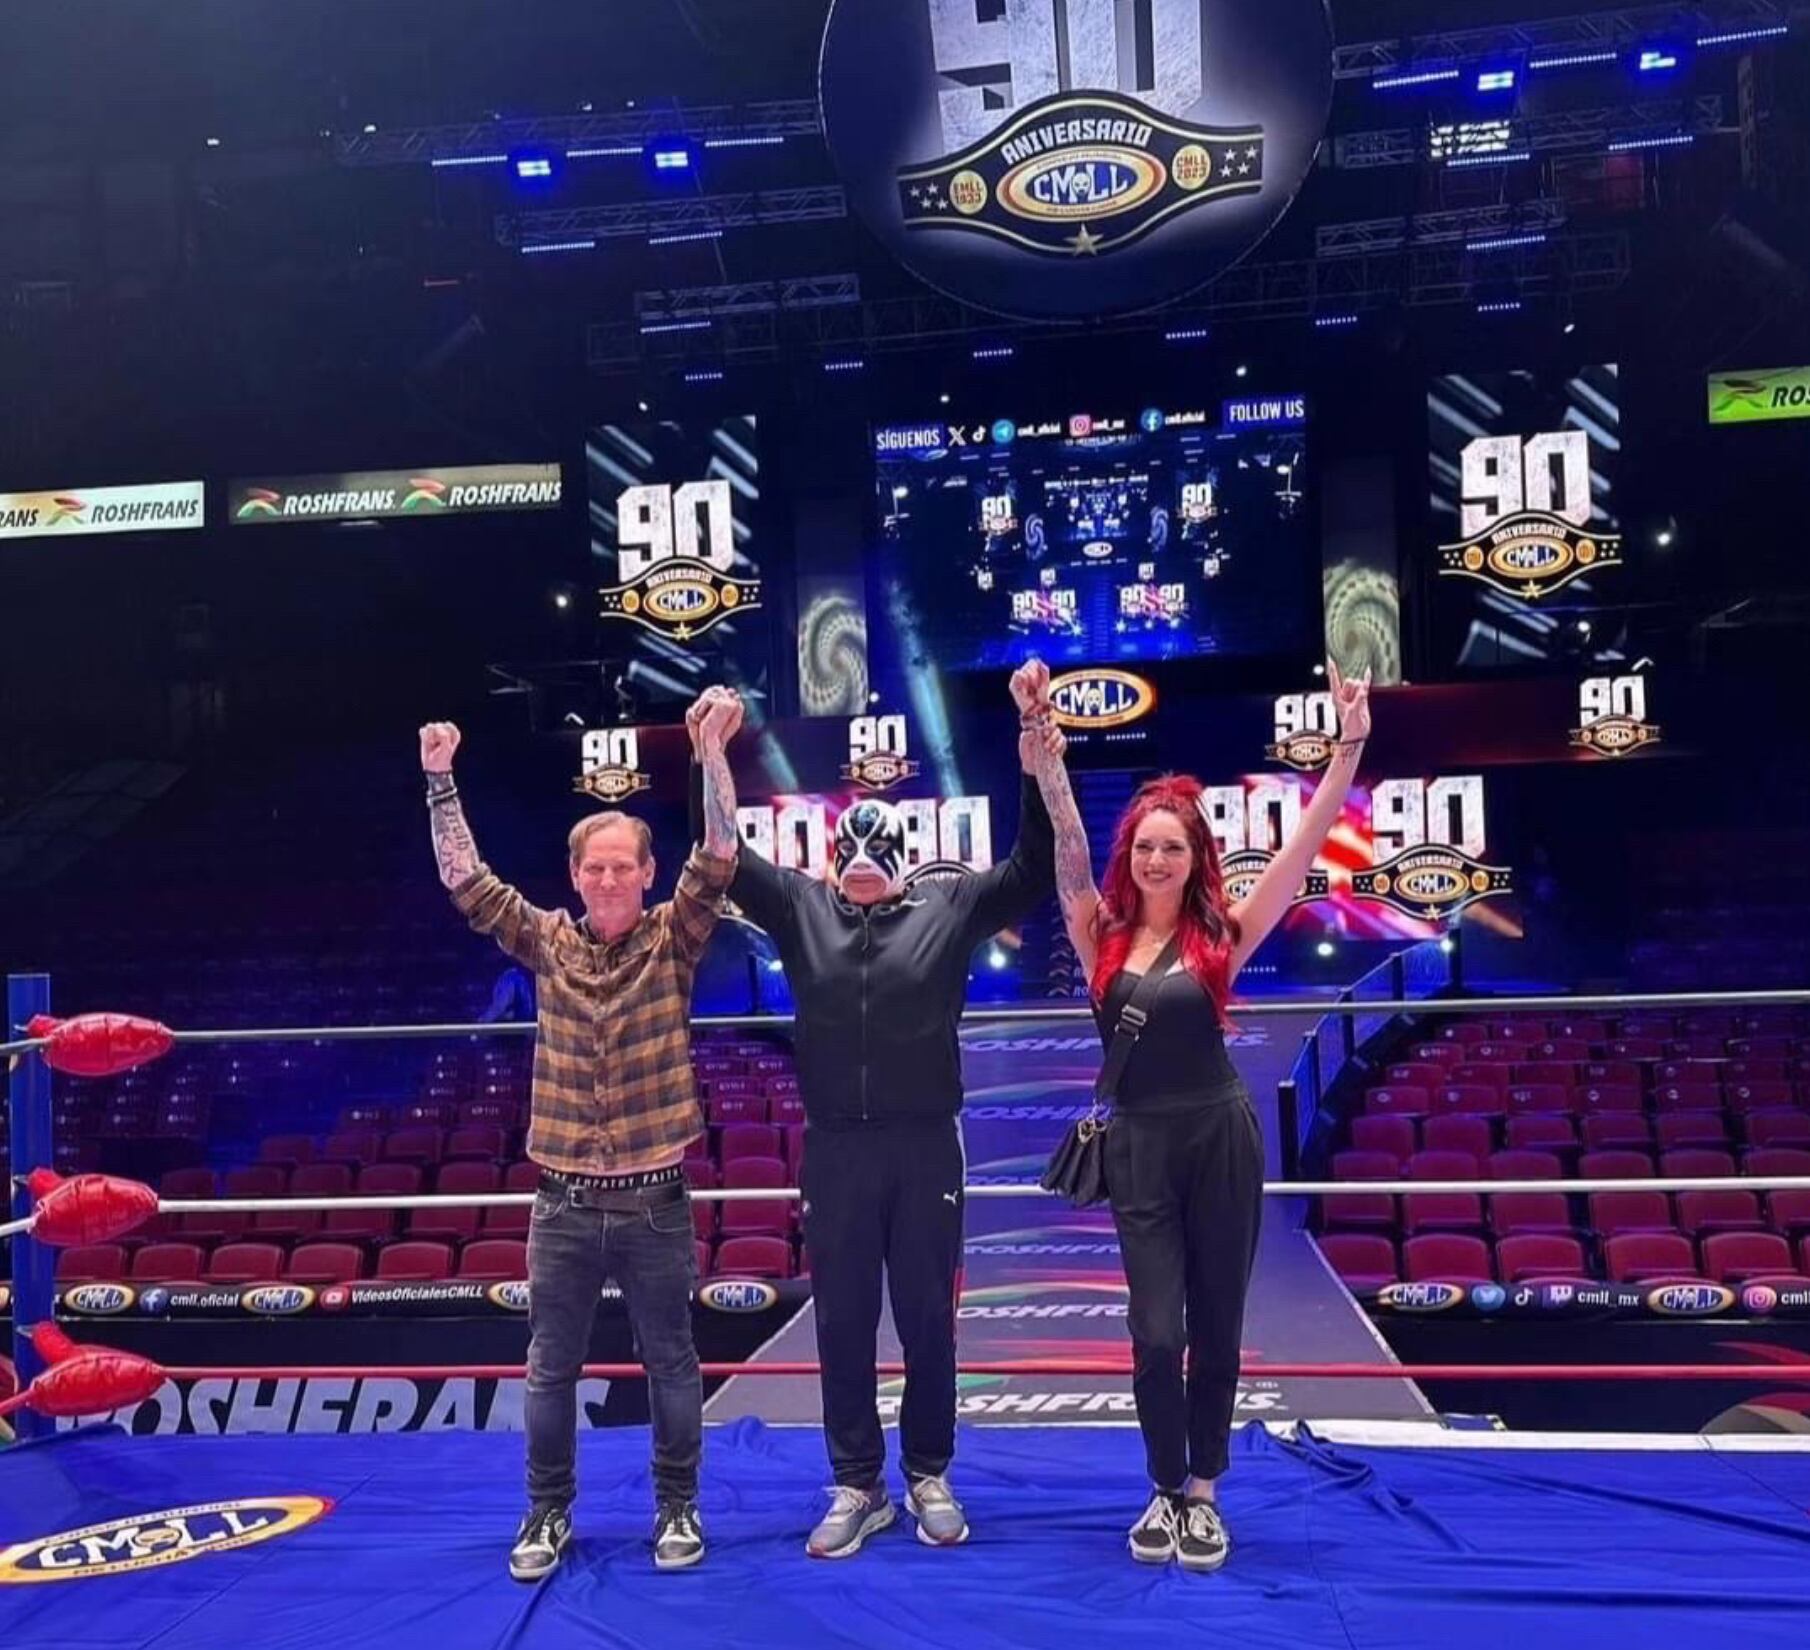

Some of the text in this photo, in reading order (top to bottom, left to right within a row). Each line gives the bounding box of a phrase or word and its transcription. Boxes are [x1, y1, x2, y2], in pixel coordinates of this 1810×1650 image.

[1001, 118, 1152, 165] ANIVERSARIO
[1034, 163, 1128, 204] CMLL
[1229, 400, 1304, 423] FOLLOW US
[876, 428, 941, 451] SÍGUENOS
[284, 490, 396, 514] ROSHFRANS
[451, 482, 562, 506] ROSHFRANS
[1460, 430, 1591, 539] 90
[91, 499, 199, 524] ROSHFRANS
[616, 480, 734, 583] 90
[1055, 680, 1133, 716] CMLL
[1275, 691, 1337, 743] 90
[1580, 674, 1646, 729] 90
[582, 728, 638, 776] 90
[849, 714, 907, 763] 90
[1371, 776, 1486, 866] 90
[352, 1284, 483, 1304] VideosOficialesCMLL
[713, 1284, 762, 1308] CMLL
[1577, 1290, 1639, 1307] cmll_mx
[1662, 1287, 1718, 1309] CMLL
[39, 1511, 268, 1567] CMLL
